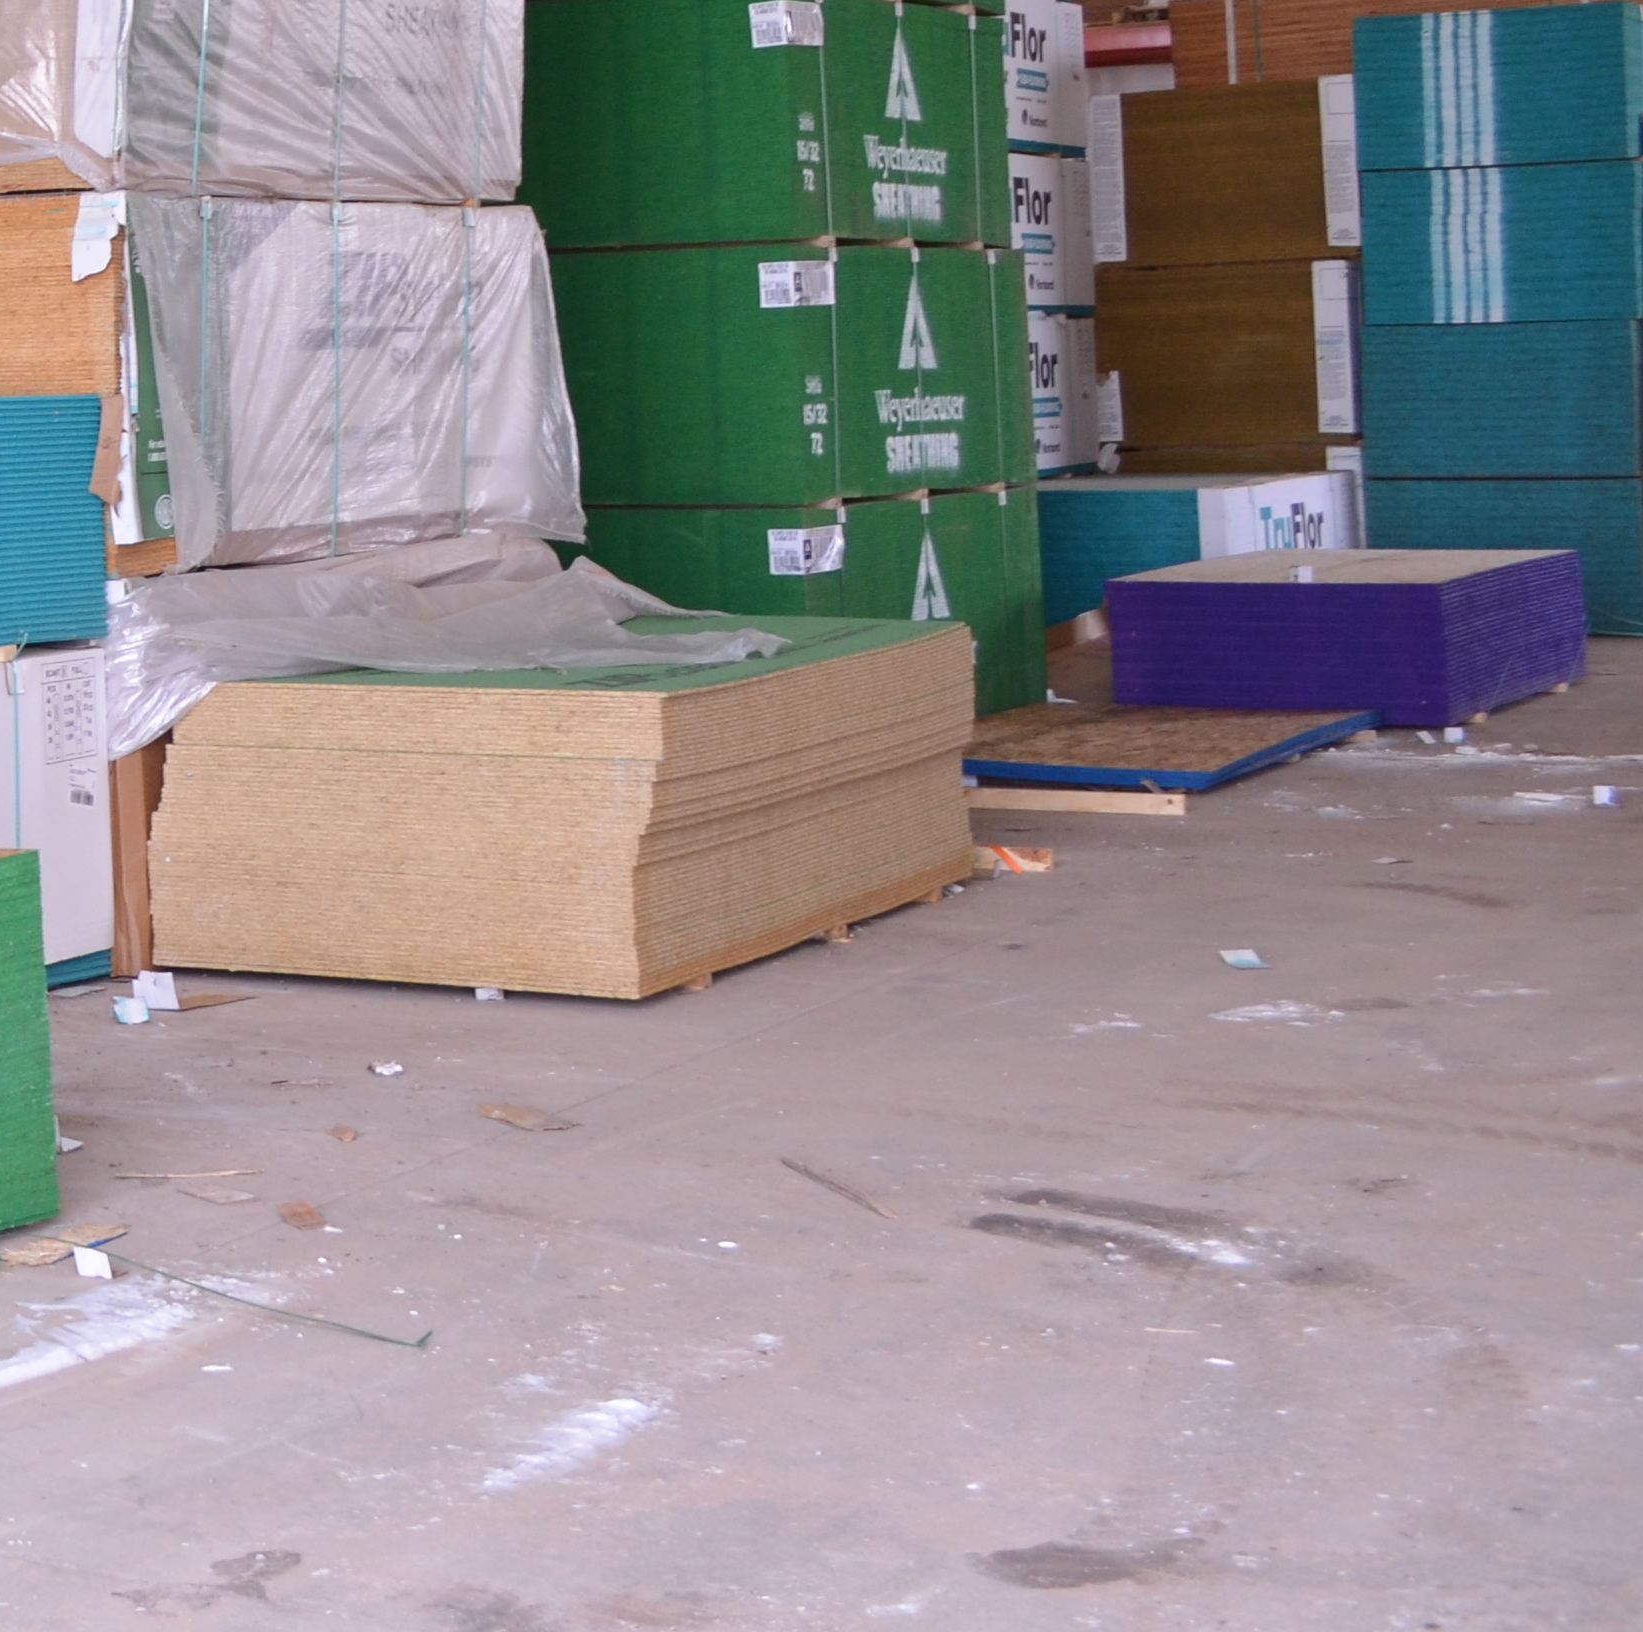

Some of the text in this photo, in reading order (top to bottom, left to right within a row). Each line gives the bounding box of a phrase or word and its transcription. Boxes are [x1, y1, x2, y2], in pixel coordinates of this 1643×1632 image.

[1010, 11, 1046, 62] Flor
[863, 134, 947, 179] Weyerhaeuser
[1013, 176, 1051, 225] Flor
[875, 386, 965, 432] Weyerhaeuser
[1259, 501, 1324, 549] TruFlor
